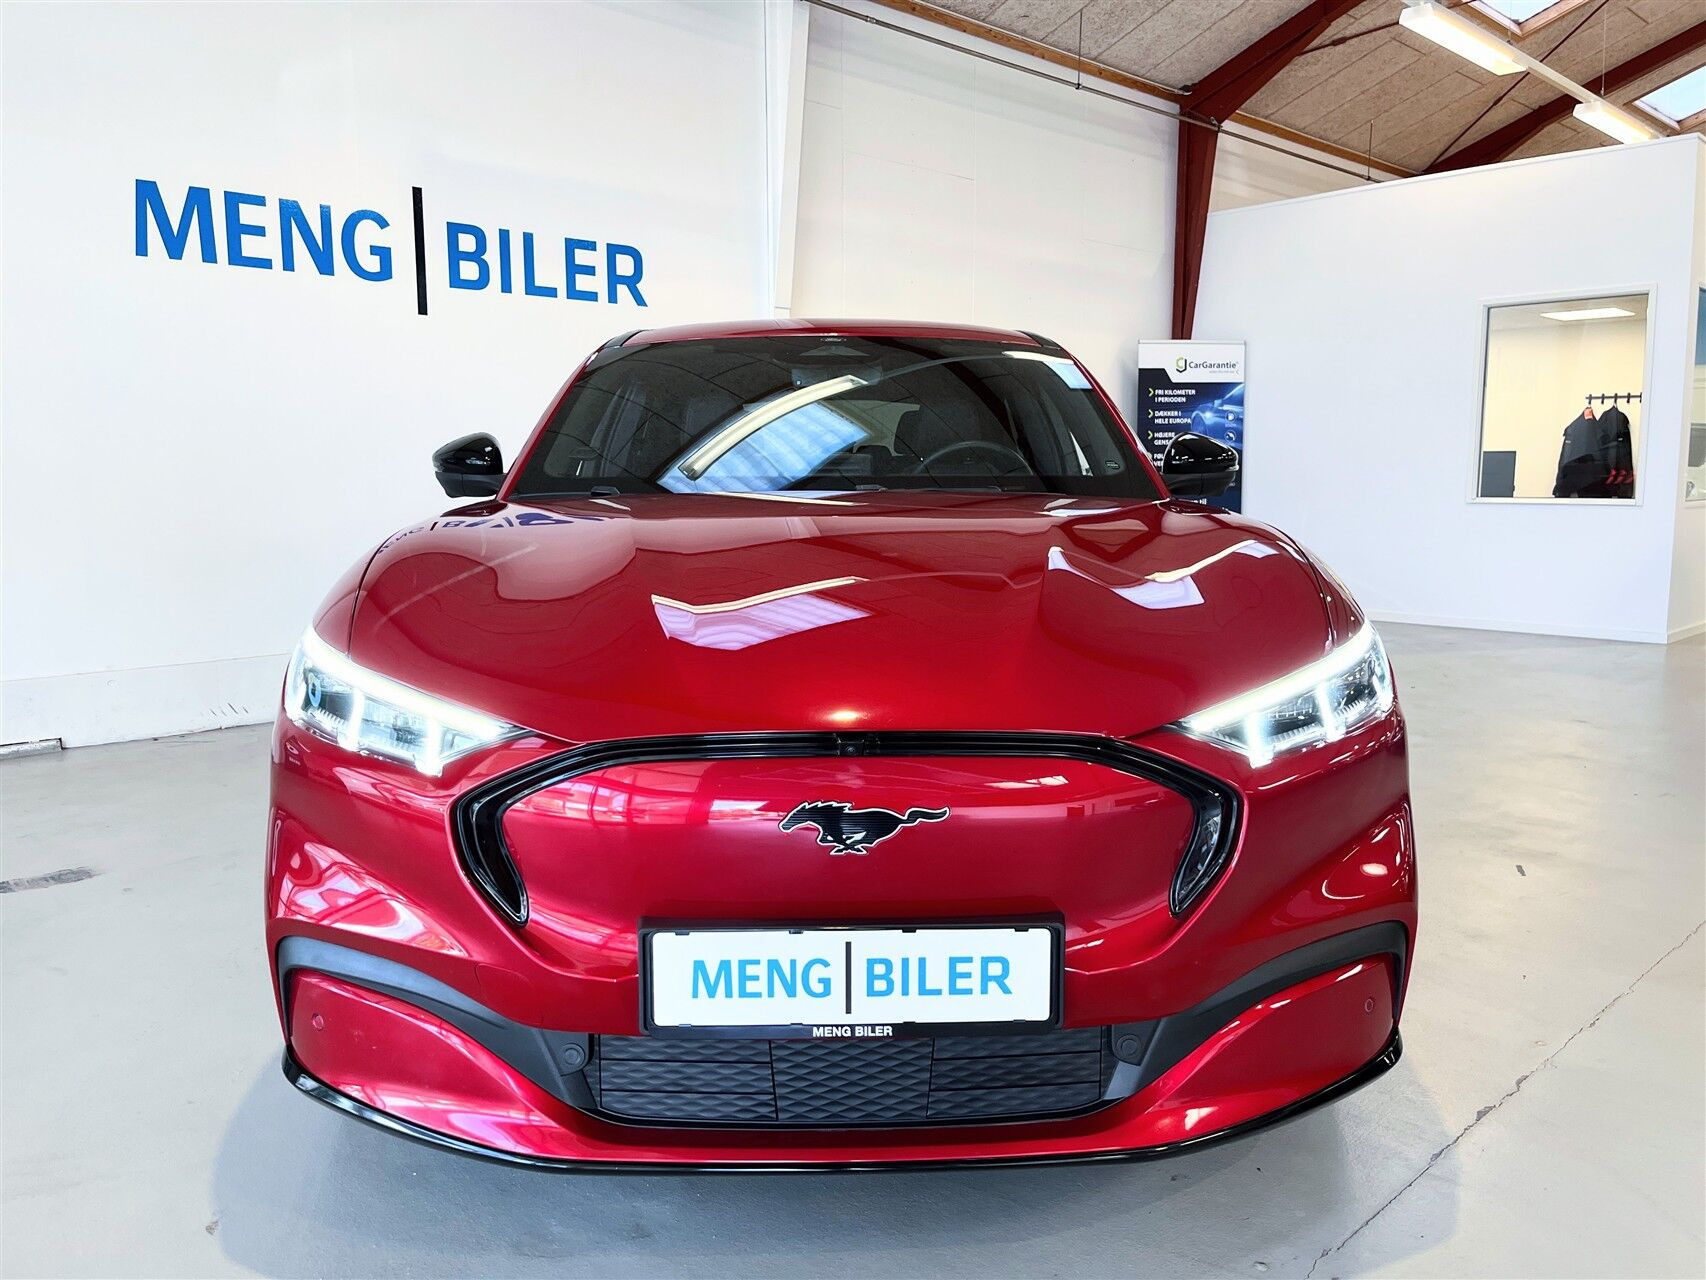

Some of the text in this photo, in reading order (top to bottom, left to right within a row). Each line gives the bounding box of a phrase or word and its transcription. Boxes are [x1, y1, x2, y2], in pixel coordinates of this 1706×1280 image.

[134, 178, 648, 307] MENG BILER
[1188, 360, 1237, 369] CarGarantie
[692, 955, 1013, 999] MENG BILER
[812, 1026, 893, 1038] MENG BILER
